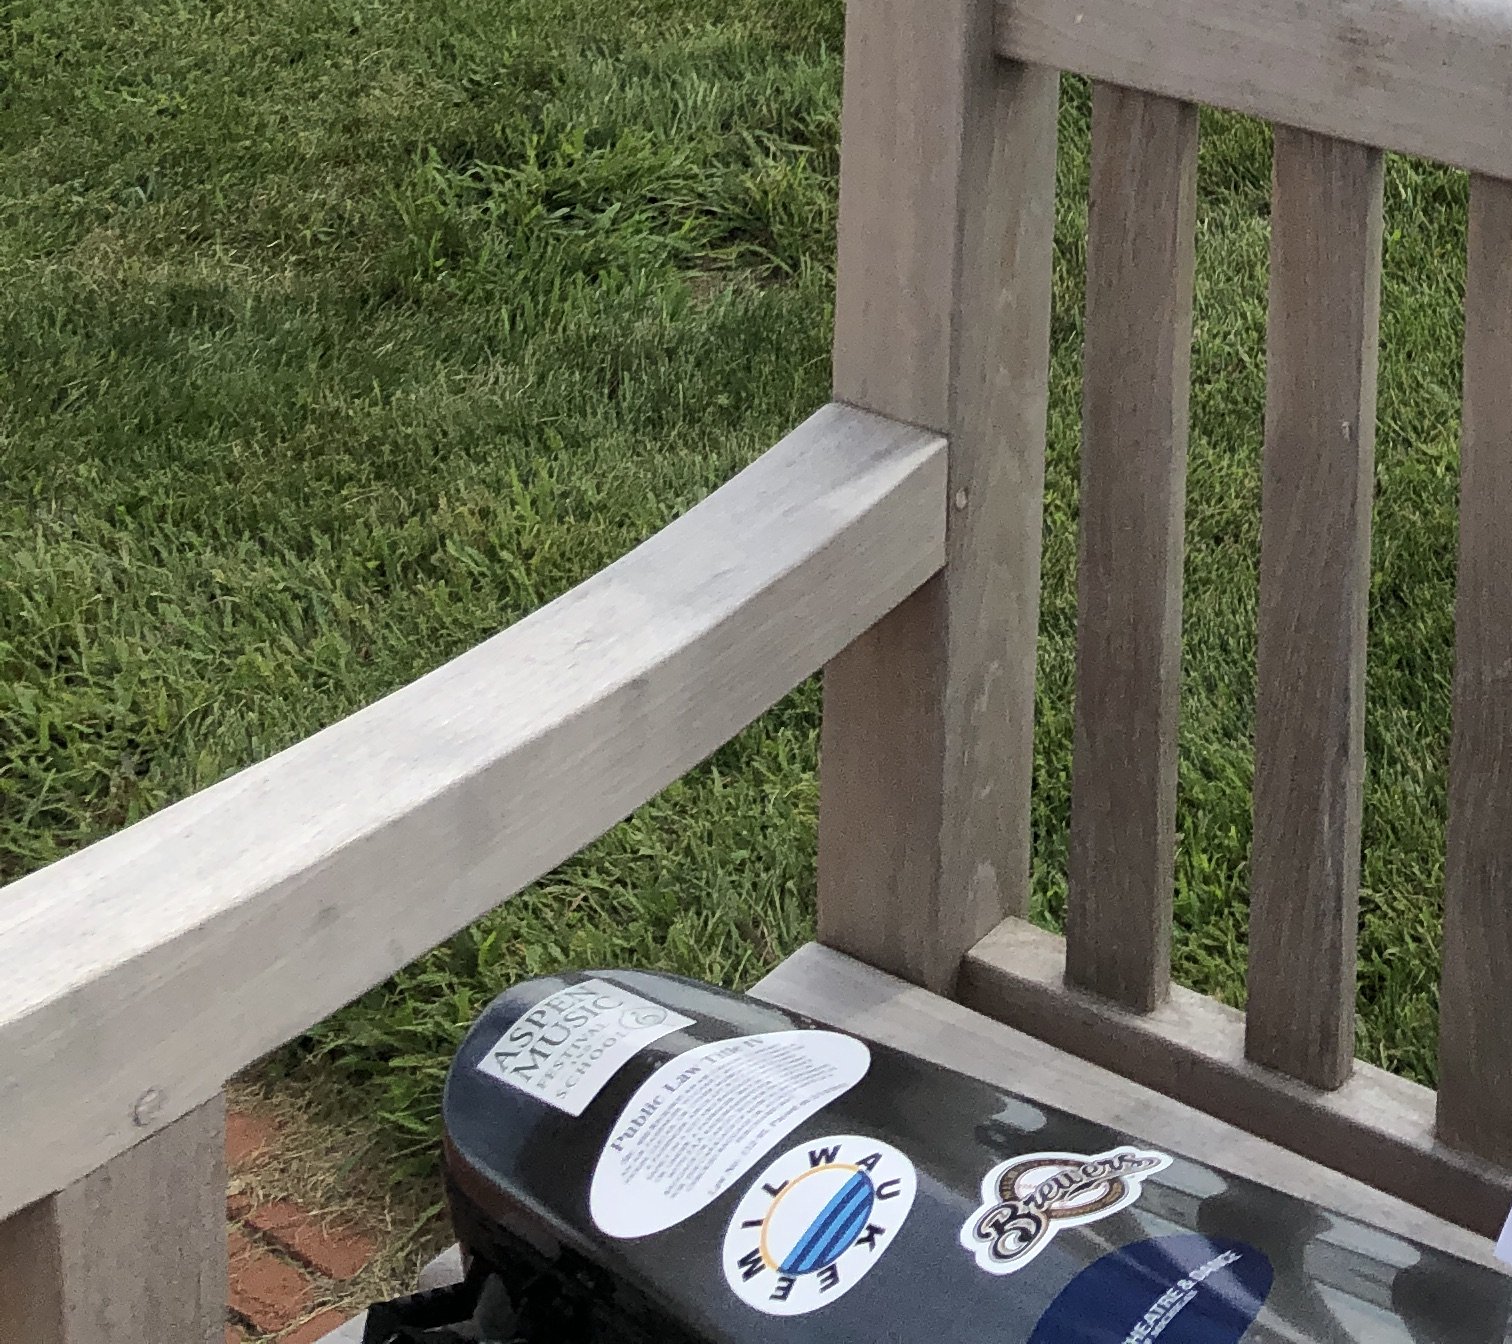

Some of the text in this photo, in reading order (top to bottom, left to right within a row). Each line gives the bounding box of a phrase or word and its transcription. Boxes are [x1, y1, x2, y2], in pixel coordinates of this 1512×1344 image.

[494, 984, 600, 1073] ASPEN
[510, 995, 624, 1083] MUSIC
[556, 1030, 628, 1099] SCHOOL
[611, 1096, 665, 1152] Public
[663, 1065, 702, 1093] Law
[737, 1144, 904, 1302] MILWAUKEE
[973, 1152, 1162, 1262] Brewers
[1121, 1288, 1185, 1344] HEATRE
